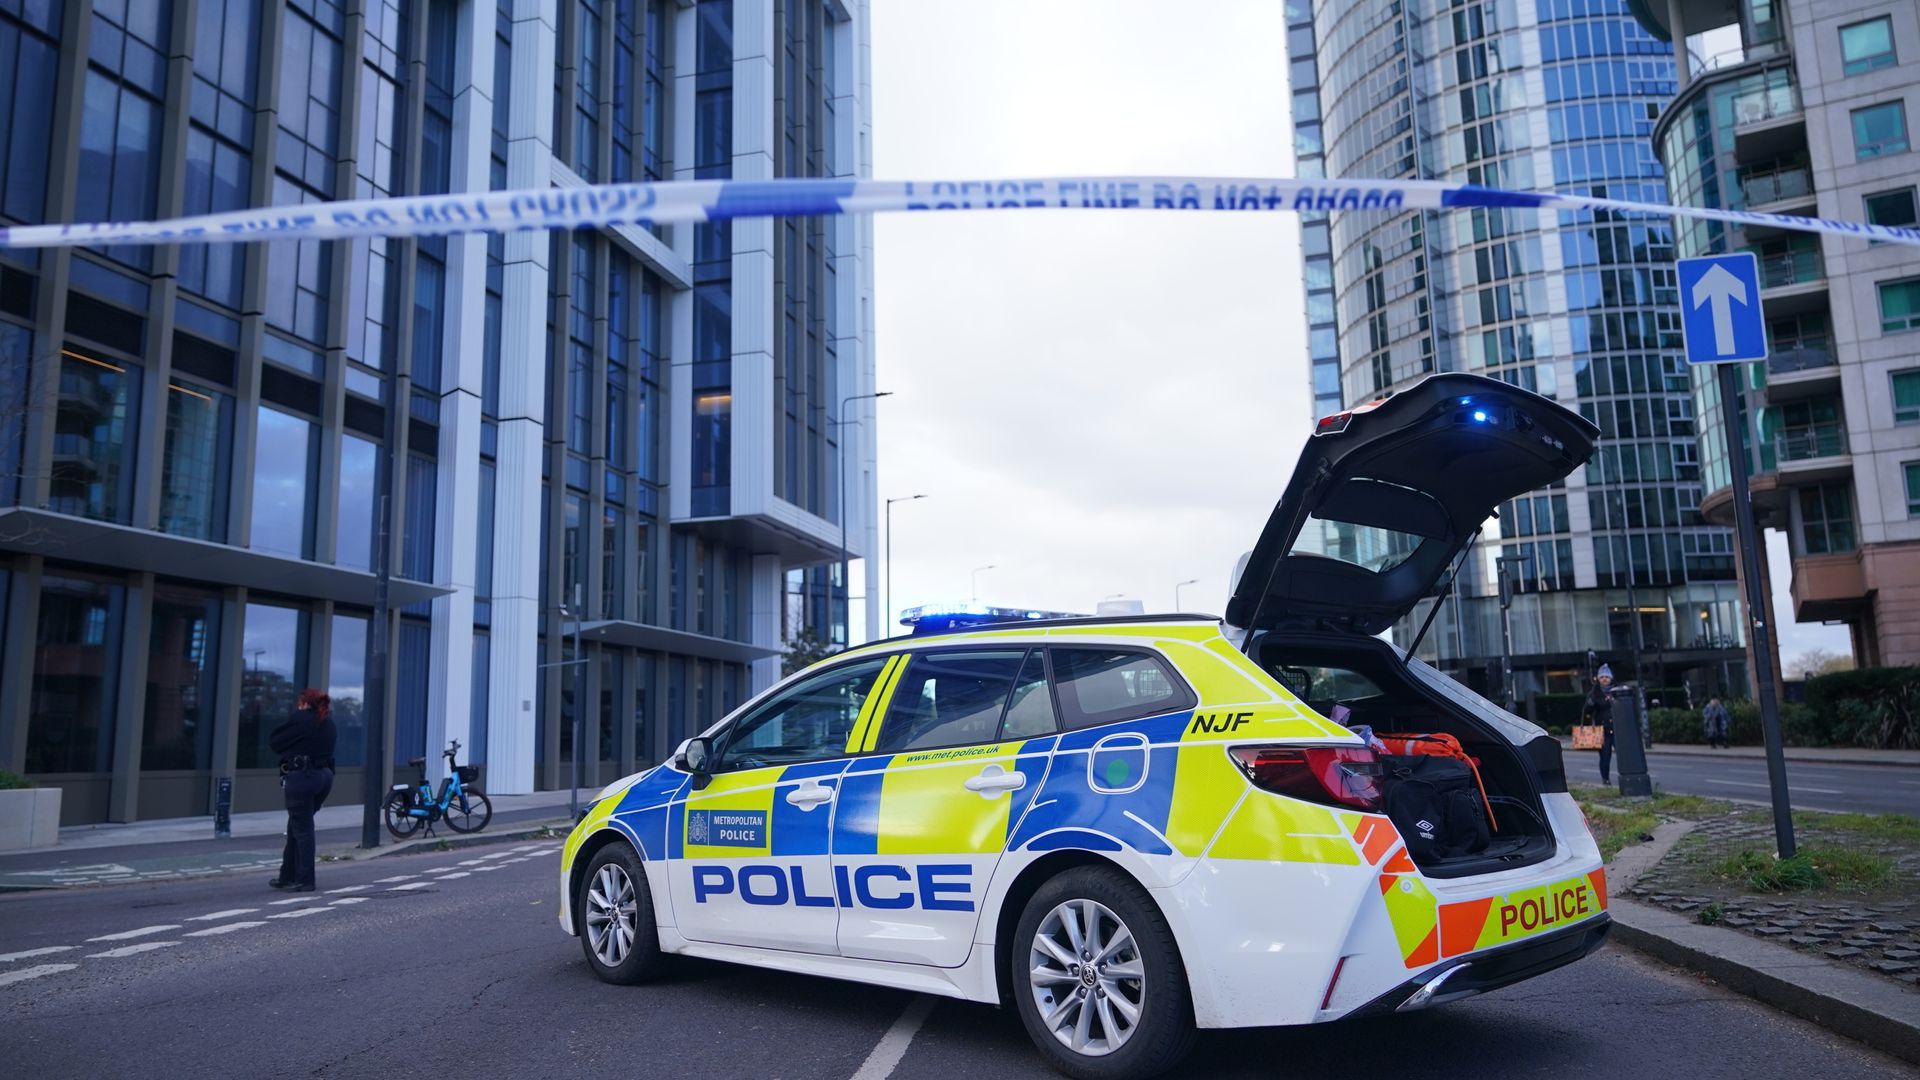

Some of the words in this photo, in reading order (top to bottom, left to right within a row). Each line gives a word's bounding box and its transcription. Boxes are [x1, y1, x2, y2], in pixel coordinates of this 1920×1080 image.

[1191, 712, 1254, 734] NJF
[906, 745, 1000, 762] www.met.police.uk
[713, 815, 763, 826] METROPOLITAN
[720, 829, 755, 841] POLICE
[692, 864, 975, 912] POLICE
[1500, 885, 1589, 937] POLICE
